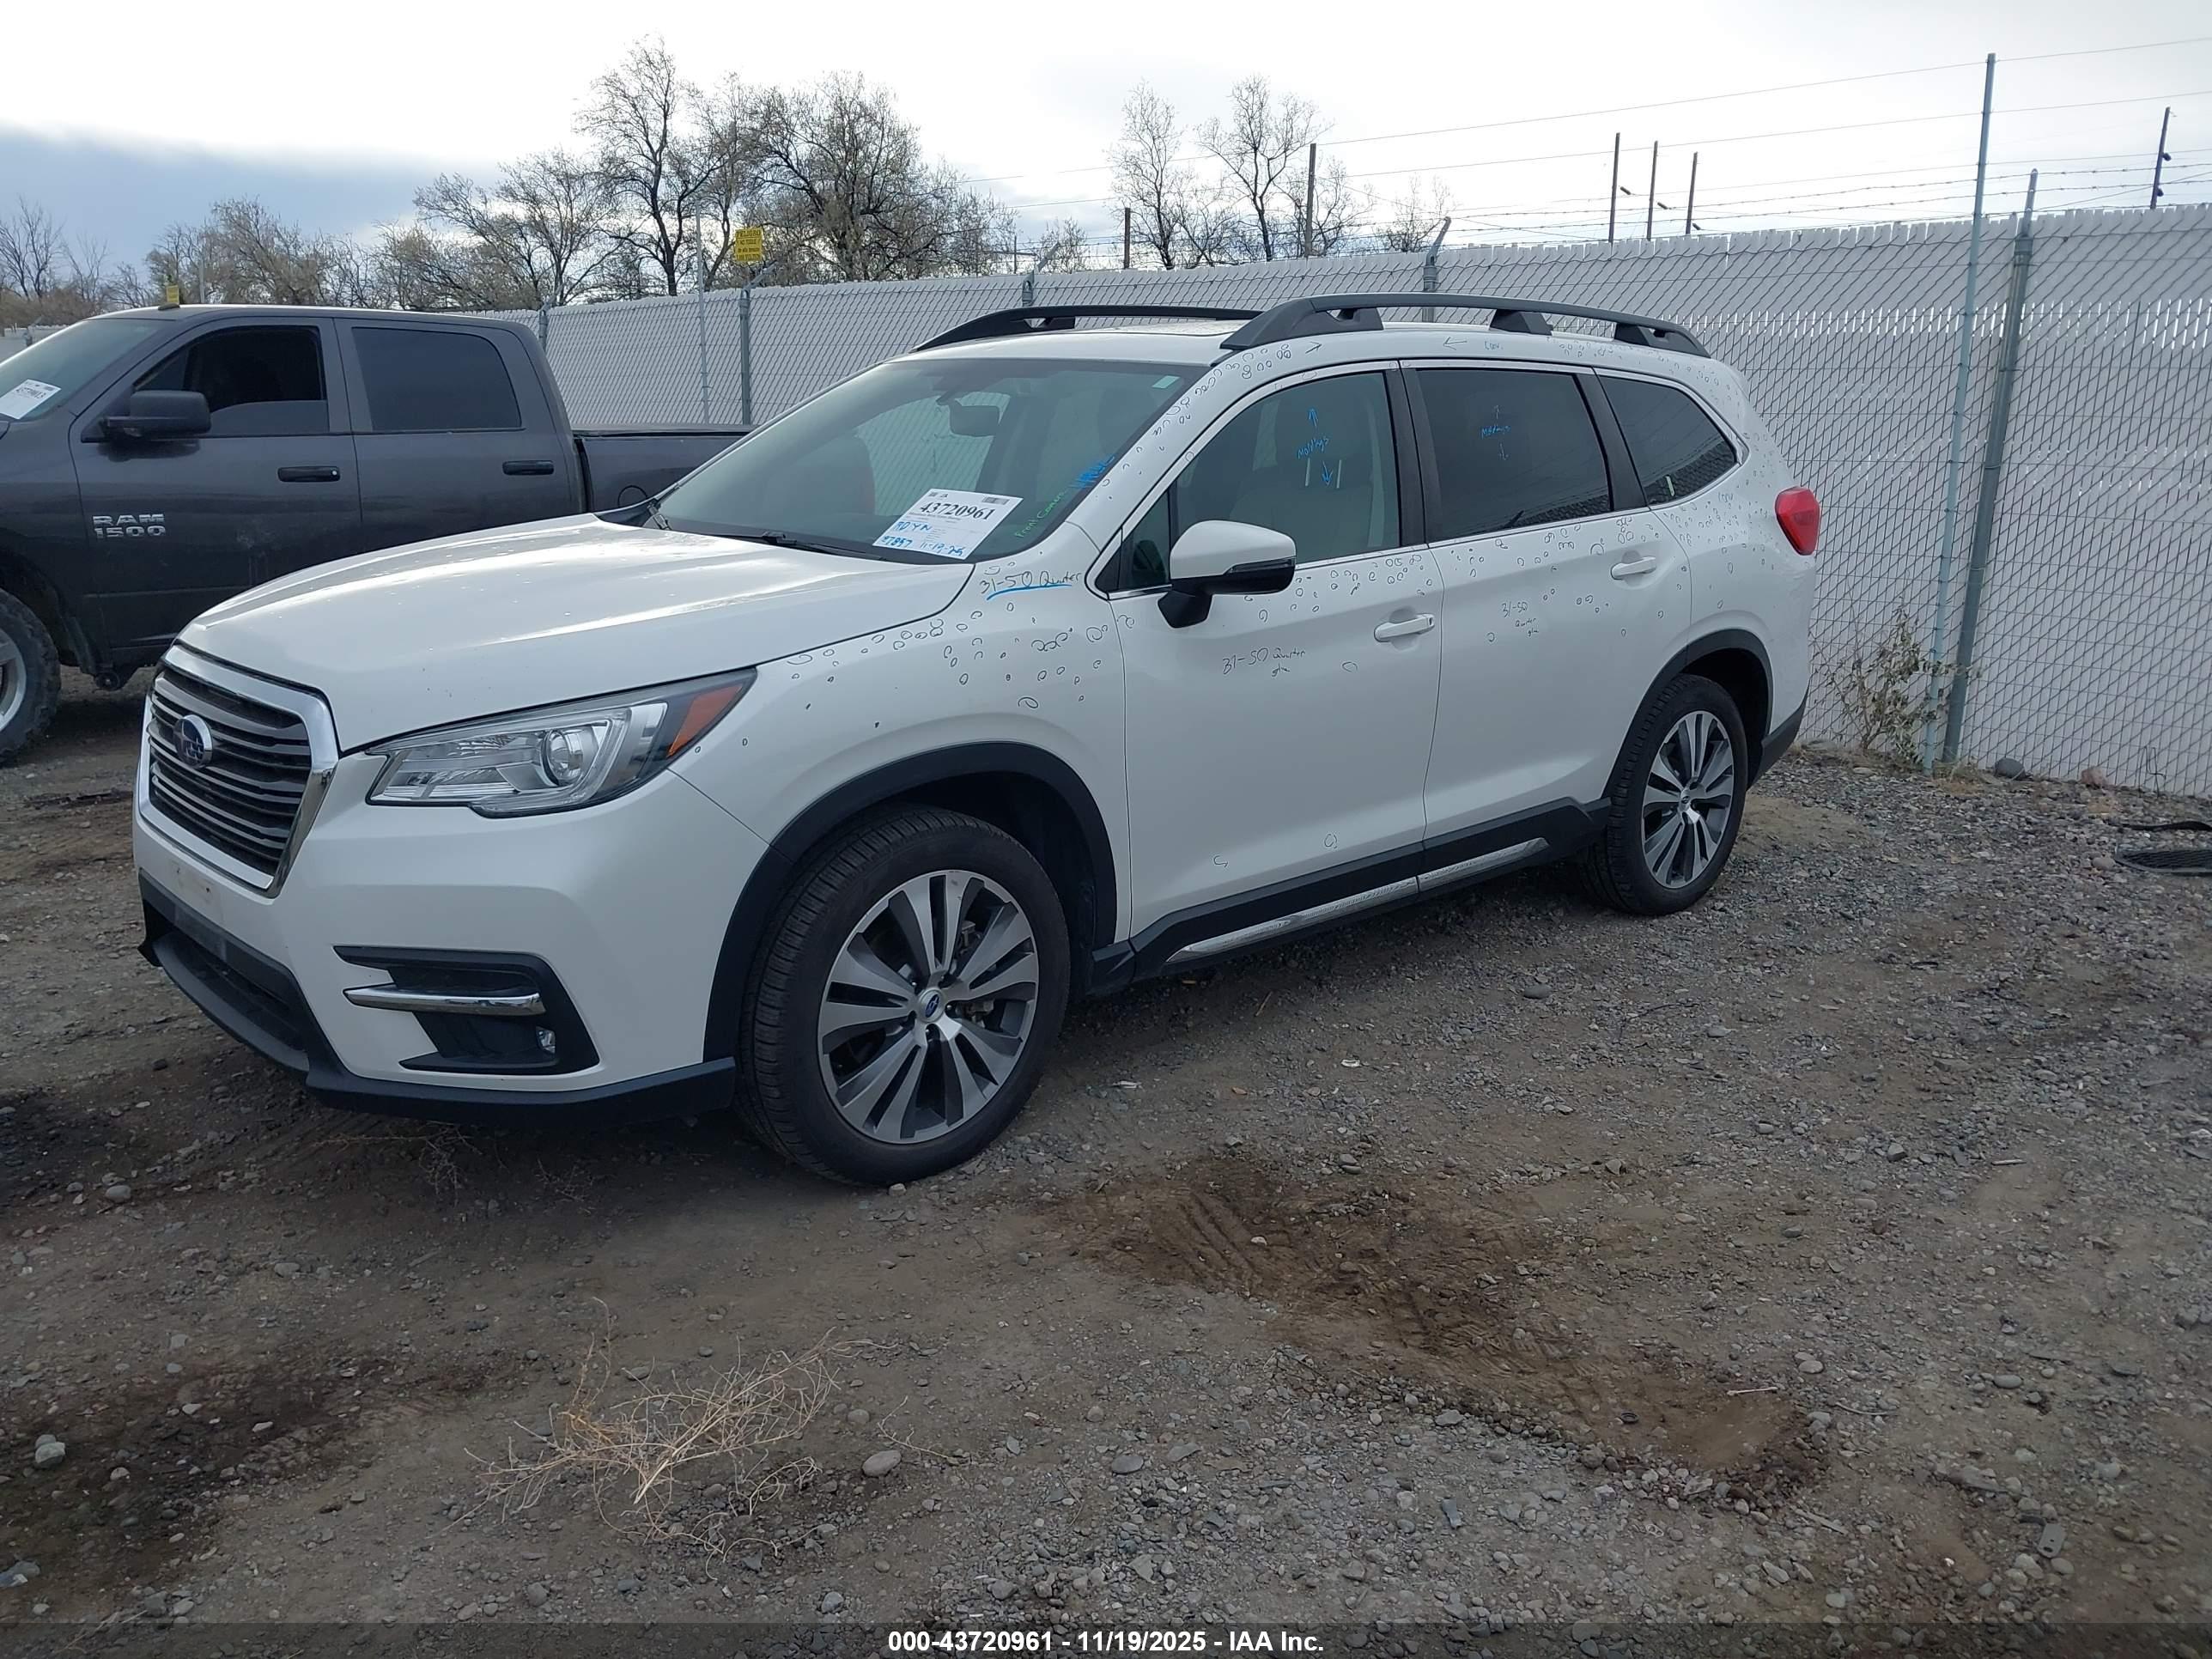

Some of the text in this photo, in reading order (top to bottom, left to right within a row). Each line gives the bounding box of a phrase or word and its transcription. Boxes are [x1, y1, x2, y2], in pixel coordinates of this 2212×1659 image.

[92, 514, 165, 526] RAM
[920, 501, 996, 521] 43720961
[94, 525, 166, 538] 1500
[980, 570, 1033, 594] 31-50
[1222, 647, 1269, 675] 31-50
